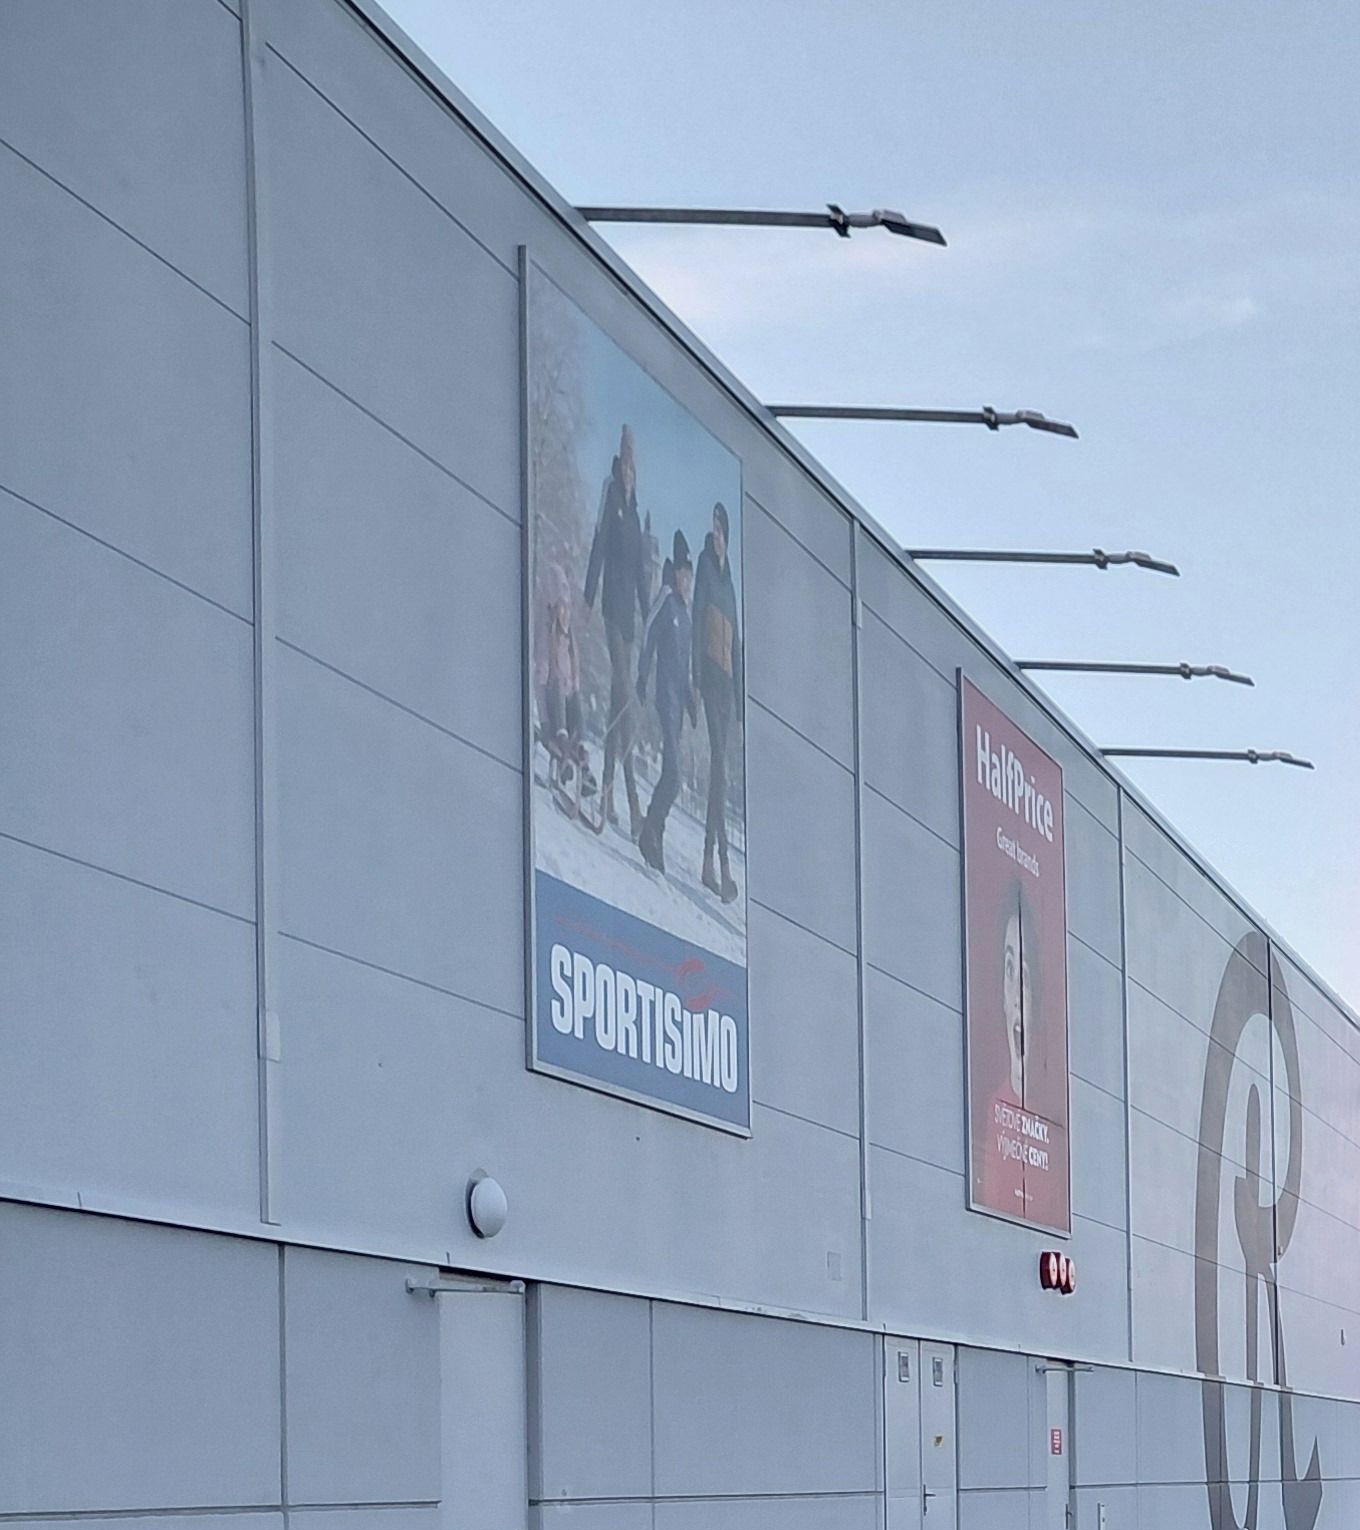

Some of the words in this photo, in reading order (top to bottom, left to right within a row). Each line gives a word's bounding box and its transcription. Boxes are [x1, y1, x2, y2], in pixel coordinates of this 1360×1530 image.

[976, 724, 1053, 842] HalfPrice
[996, 827, 1016, 861] Great
[1016, 840, 1039, 878] brands
[551, 944, 738, 1093] SPORTISIMO
